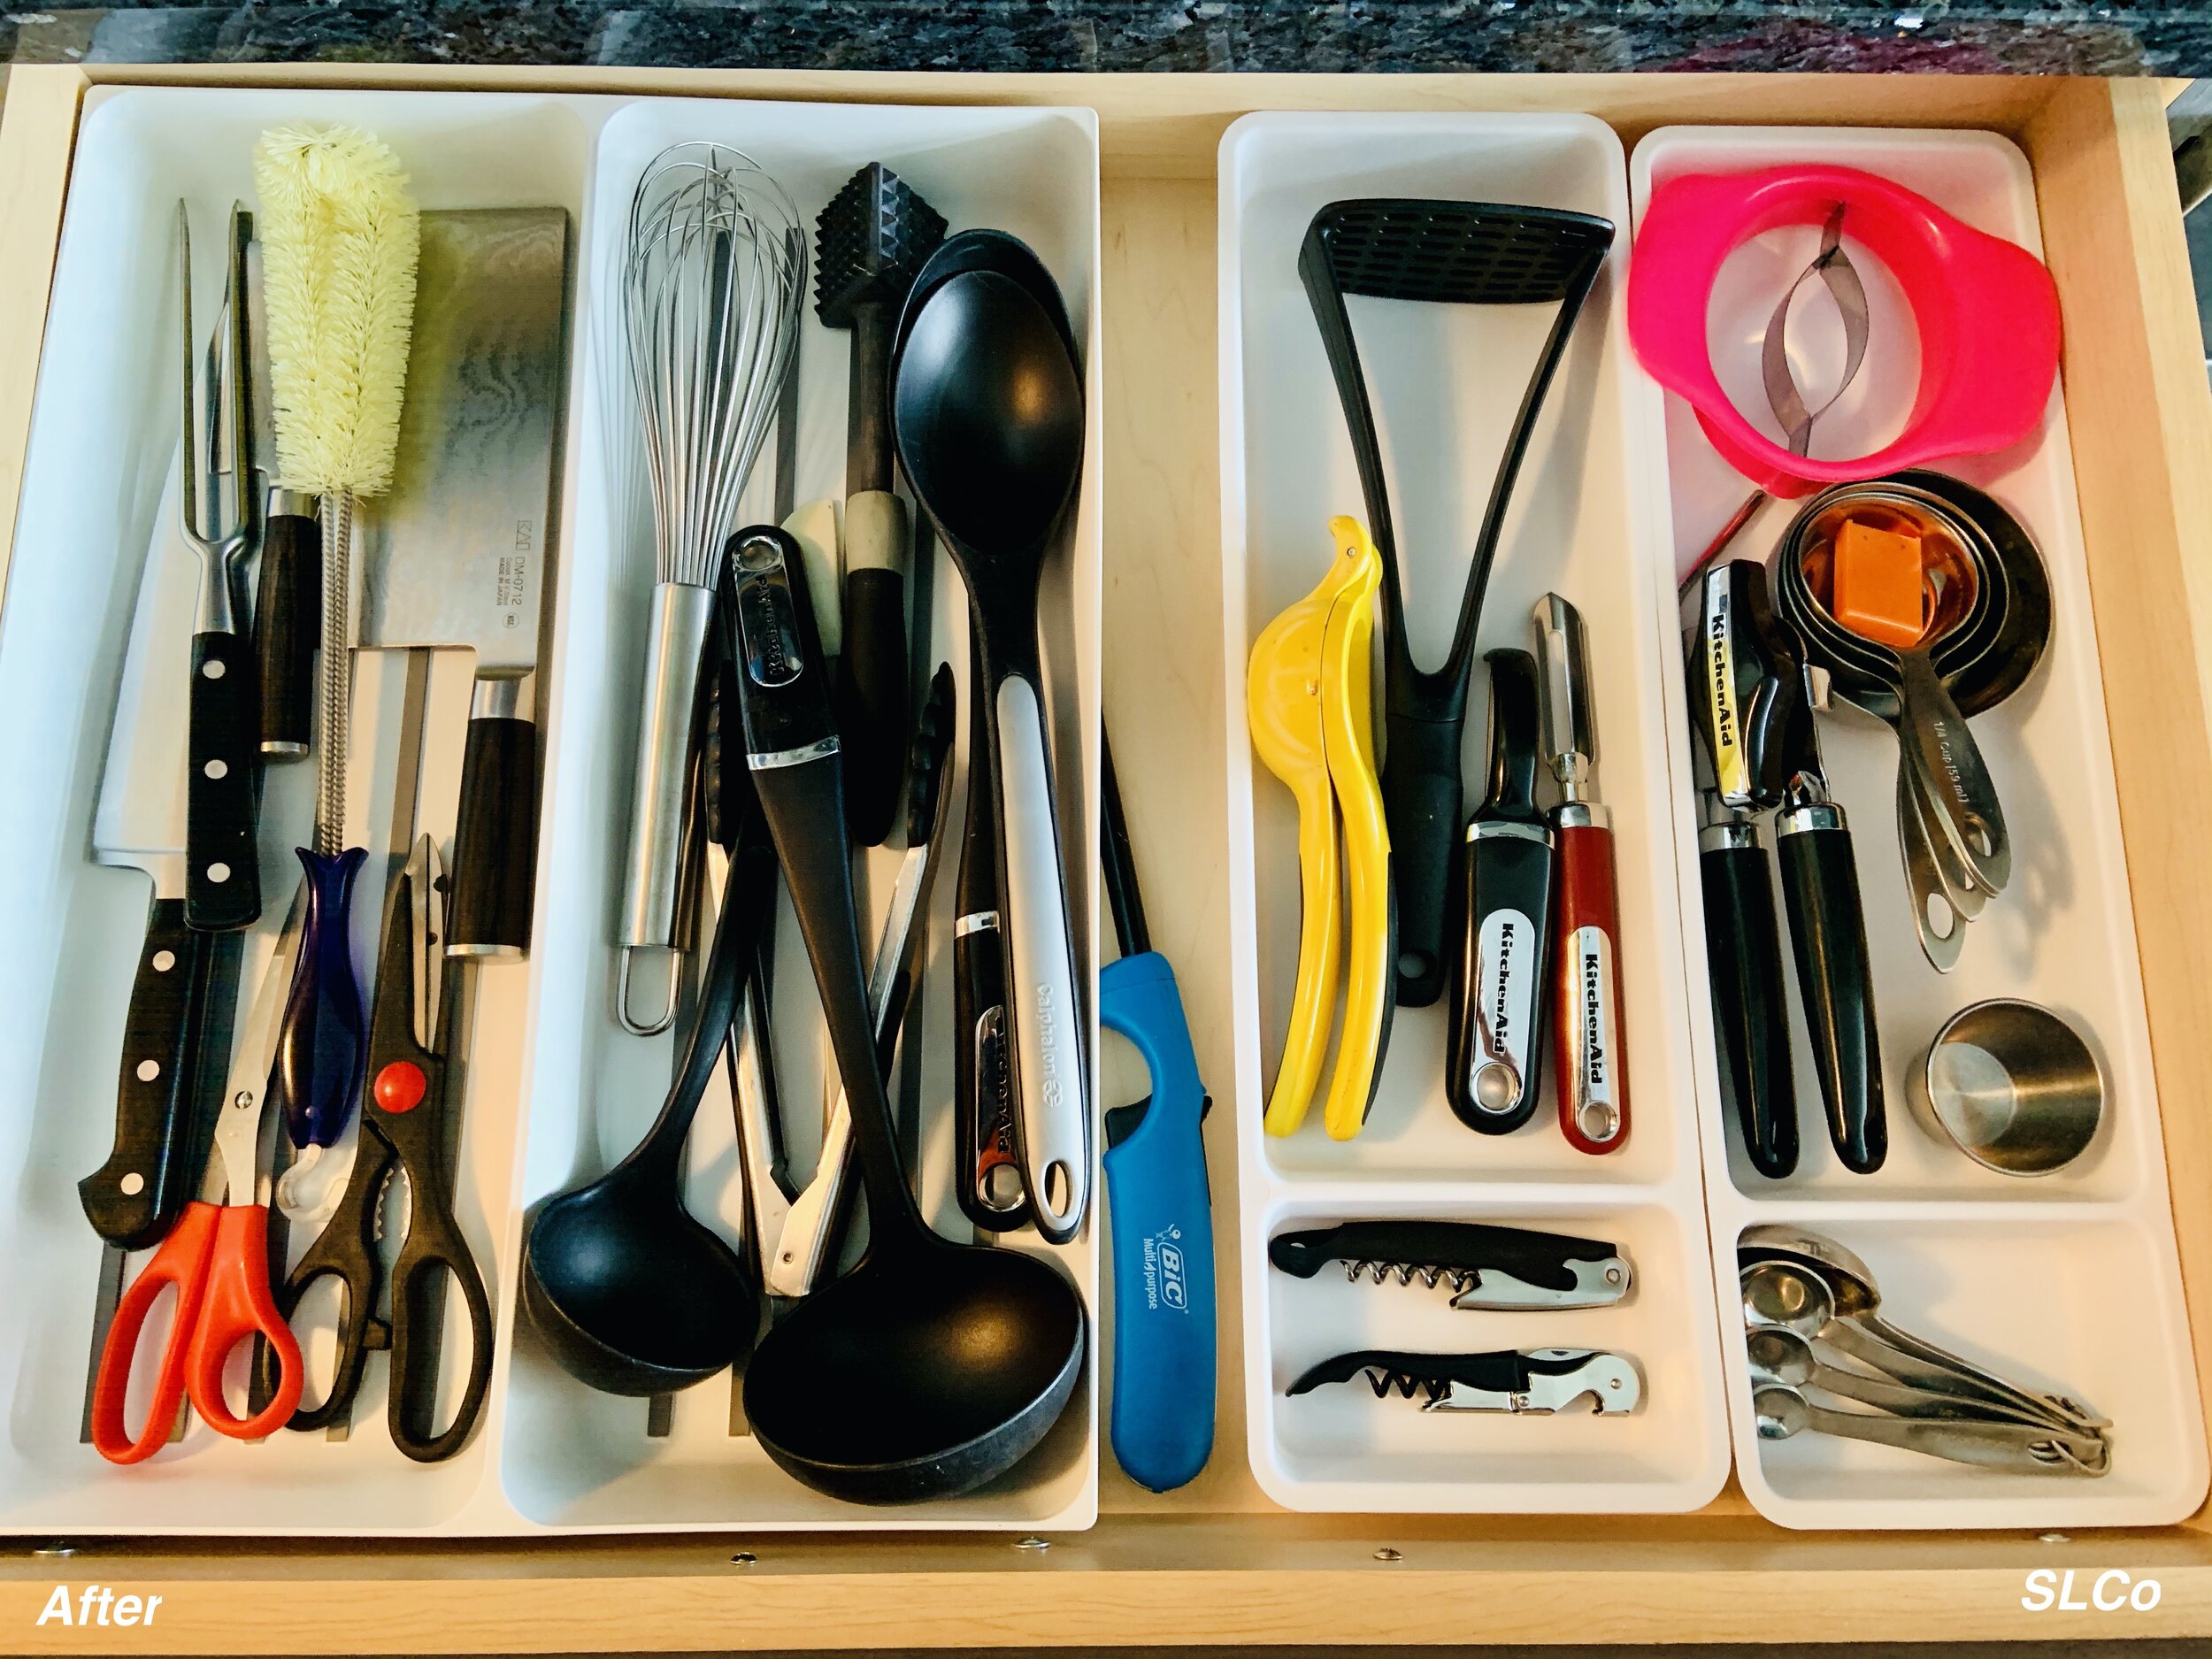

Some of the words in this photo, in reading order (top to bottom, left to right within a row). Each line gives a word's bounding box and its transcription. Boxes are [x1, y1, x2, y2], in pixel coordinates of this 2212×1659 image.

[511, 556, 526, 606] DM-0712
[756, 573, 785, 676] KitchenAid
[1712, 614, 1733, 747] KitchenAid
[1933, 721, 1947, 738] 1/4
[1939, 741, 1952, 764] Cup
[1036, 982, 1059, 1076] Calphalon
[1494, 923, 1515, 1053] KitchenAid
[1585, 954, 1603, 1084] KitchenAid
